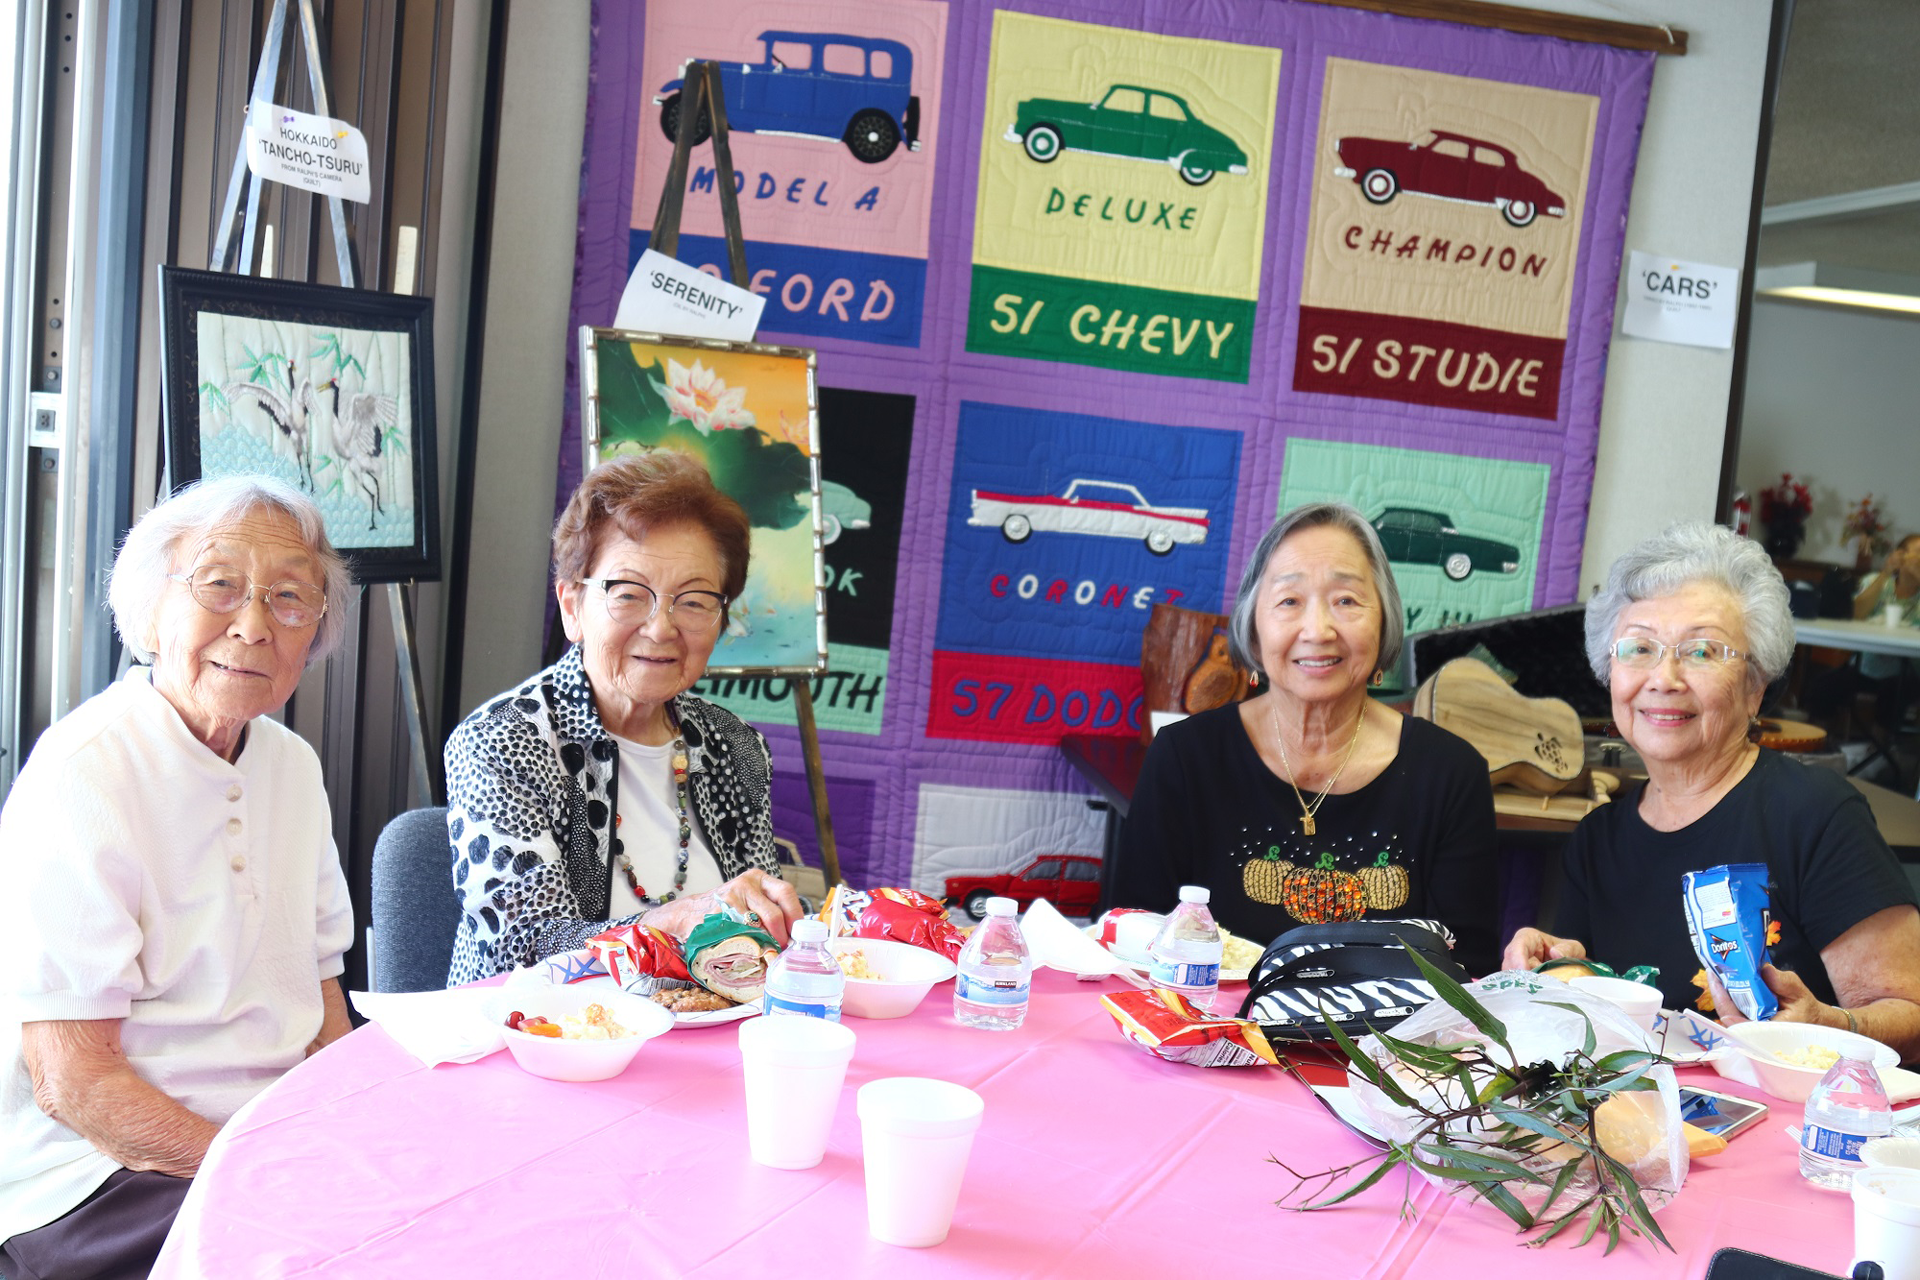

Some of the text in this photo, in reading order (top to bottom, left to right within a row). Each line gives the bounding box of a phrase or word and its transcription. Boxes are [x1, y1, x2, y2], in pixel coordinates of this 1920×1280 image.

[259, 139, 363, 176] 'TANCHO-TSURU'
[280, 127, 337, 150] HOKKAIDO
[854, 186, 880, 211] A
[1046, 187, 1197, 230] DELUXE
[1345, 225, 1548, 278] CHAMPION
[650, 270, 743, 319] 'SERENITY'
[750, 269, 896, 322] FORD
[1642, 270, 1718, 299] 'CARS'
[990, 293, 1234, 359] 51 CHEVY
[1312, 335, 1543, 397] 51 STUDIE
[990, 574, 1184, 609] CORONET
[952, 679, 1014, 721] 57
[1711, 939, 1738, 954] Doritos
[1217, 1042, 1233, 1063] Calories
